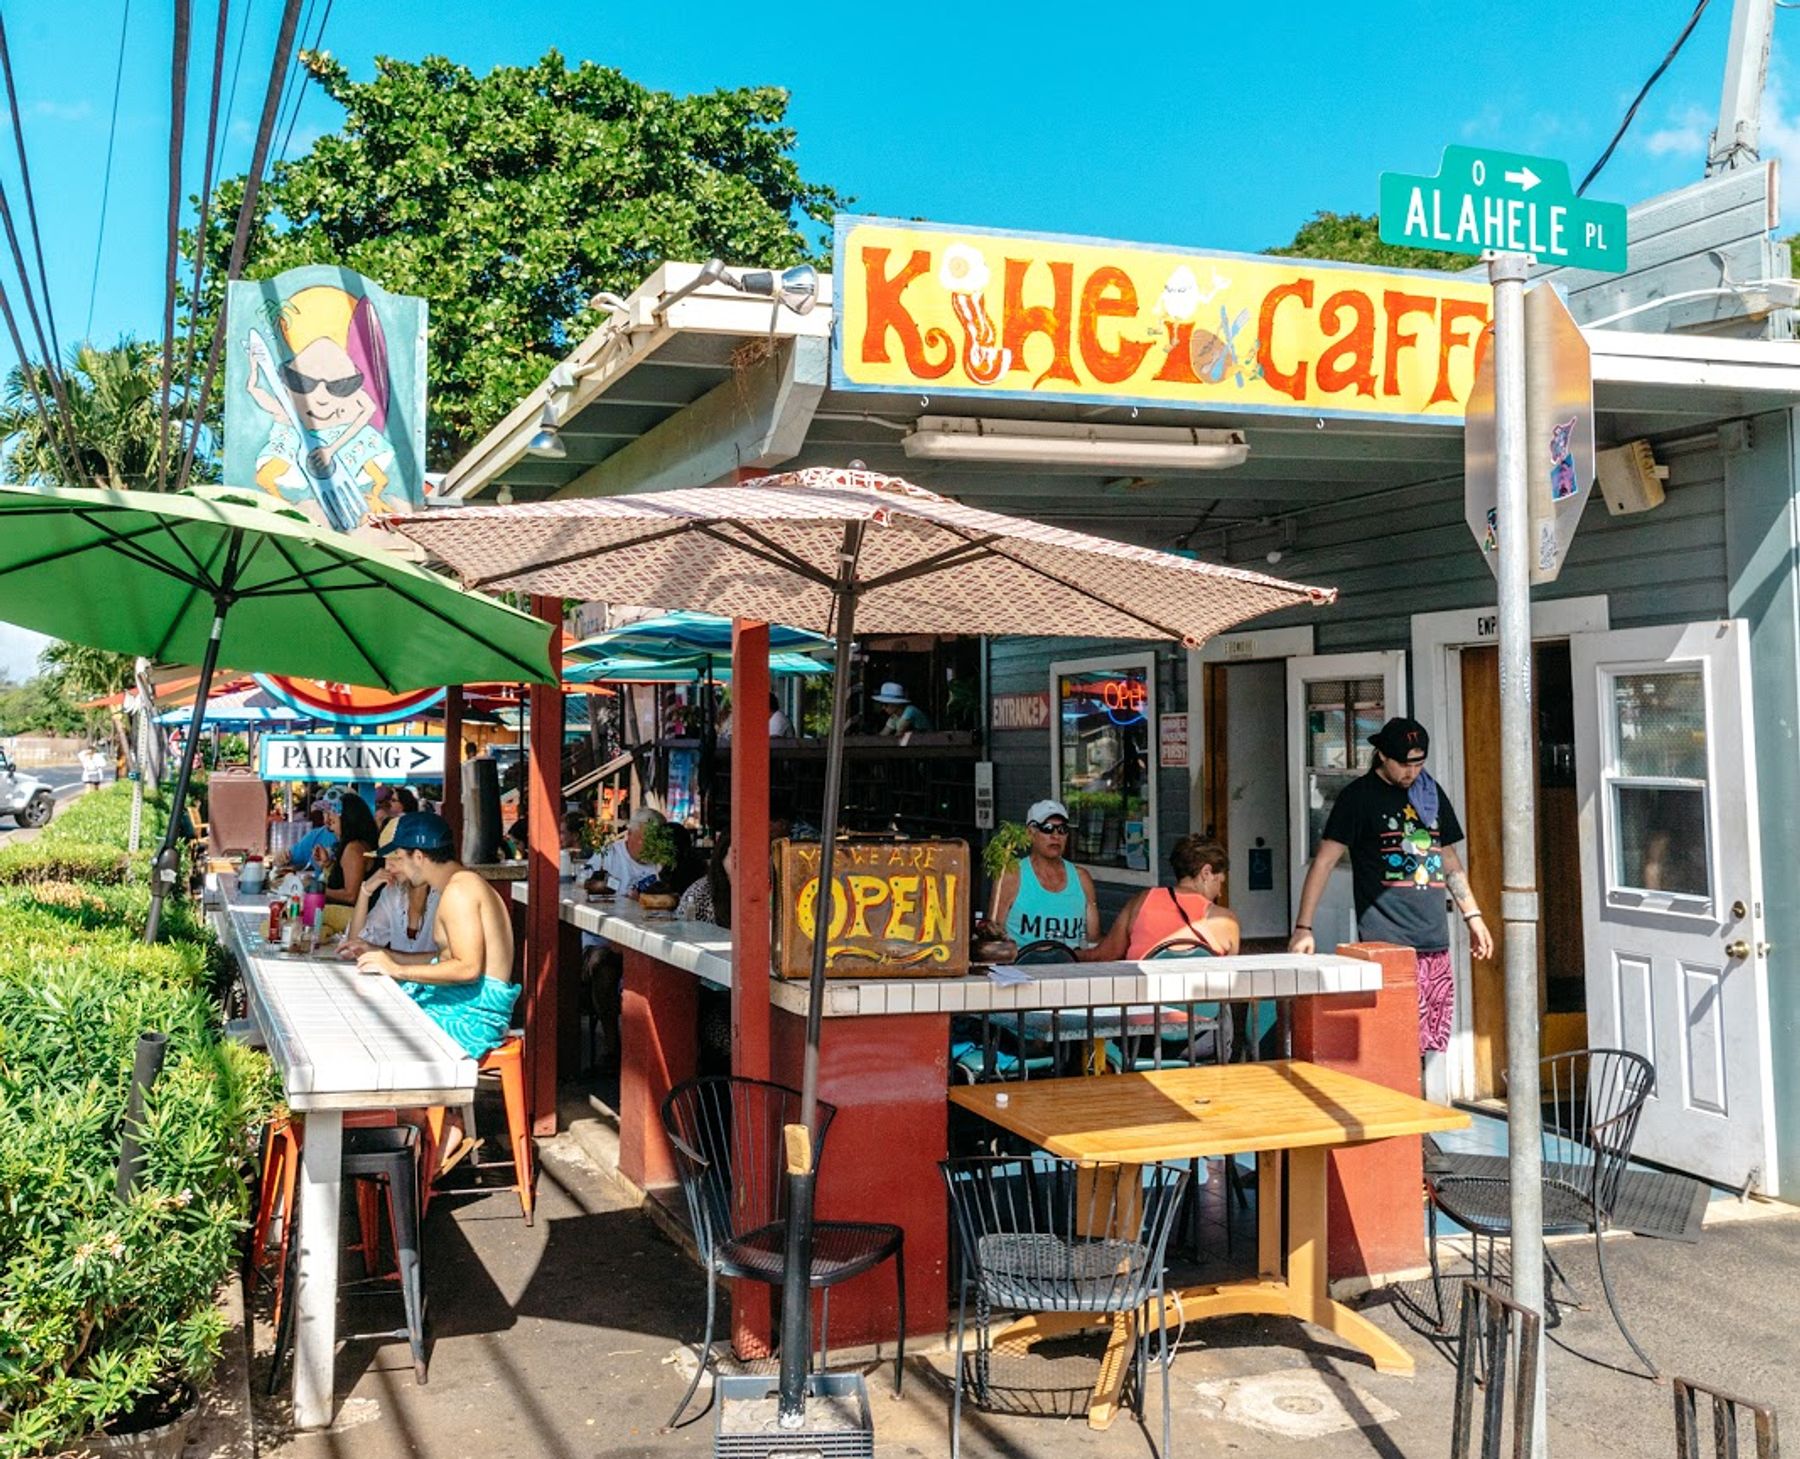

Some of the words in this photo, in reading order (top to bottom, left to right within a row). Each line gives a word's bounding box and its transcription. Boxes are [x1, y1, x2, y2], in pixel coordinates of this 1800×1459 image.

[1404, 187, 1568, 256] ALAHELE
[1585, 222, 1607, 250] PL
[1258, 278, 1494, 412] CaFF
[993, 696, 1040, 727] ENTRANCE
[281, 745, 401, 769] PARKING
[850, 847, 880, 866] WE
[887, 847, 943, 873] ARE
[796, 873, 958, 944] OPEN
